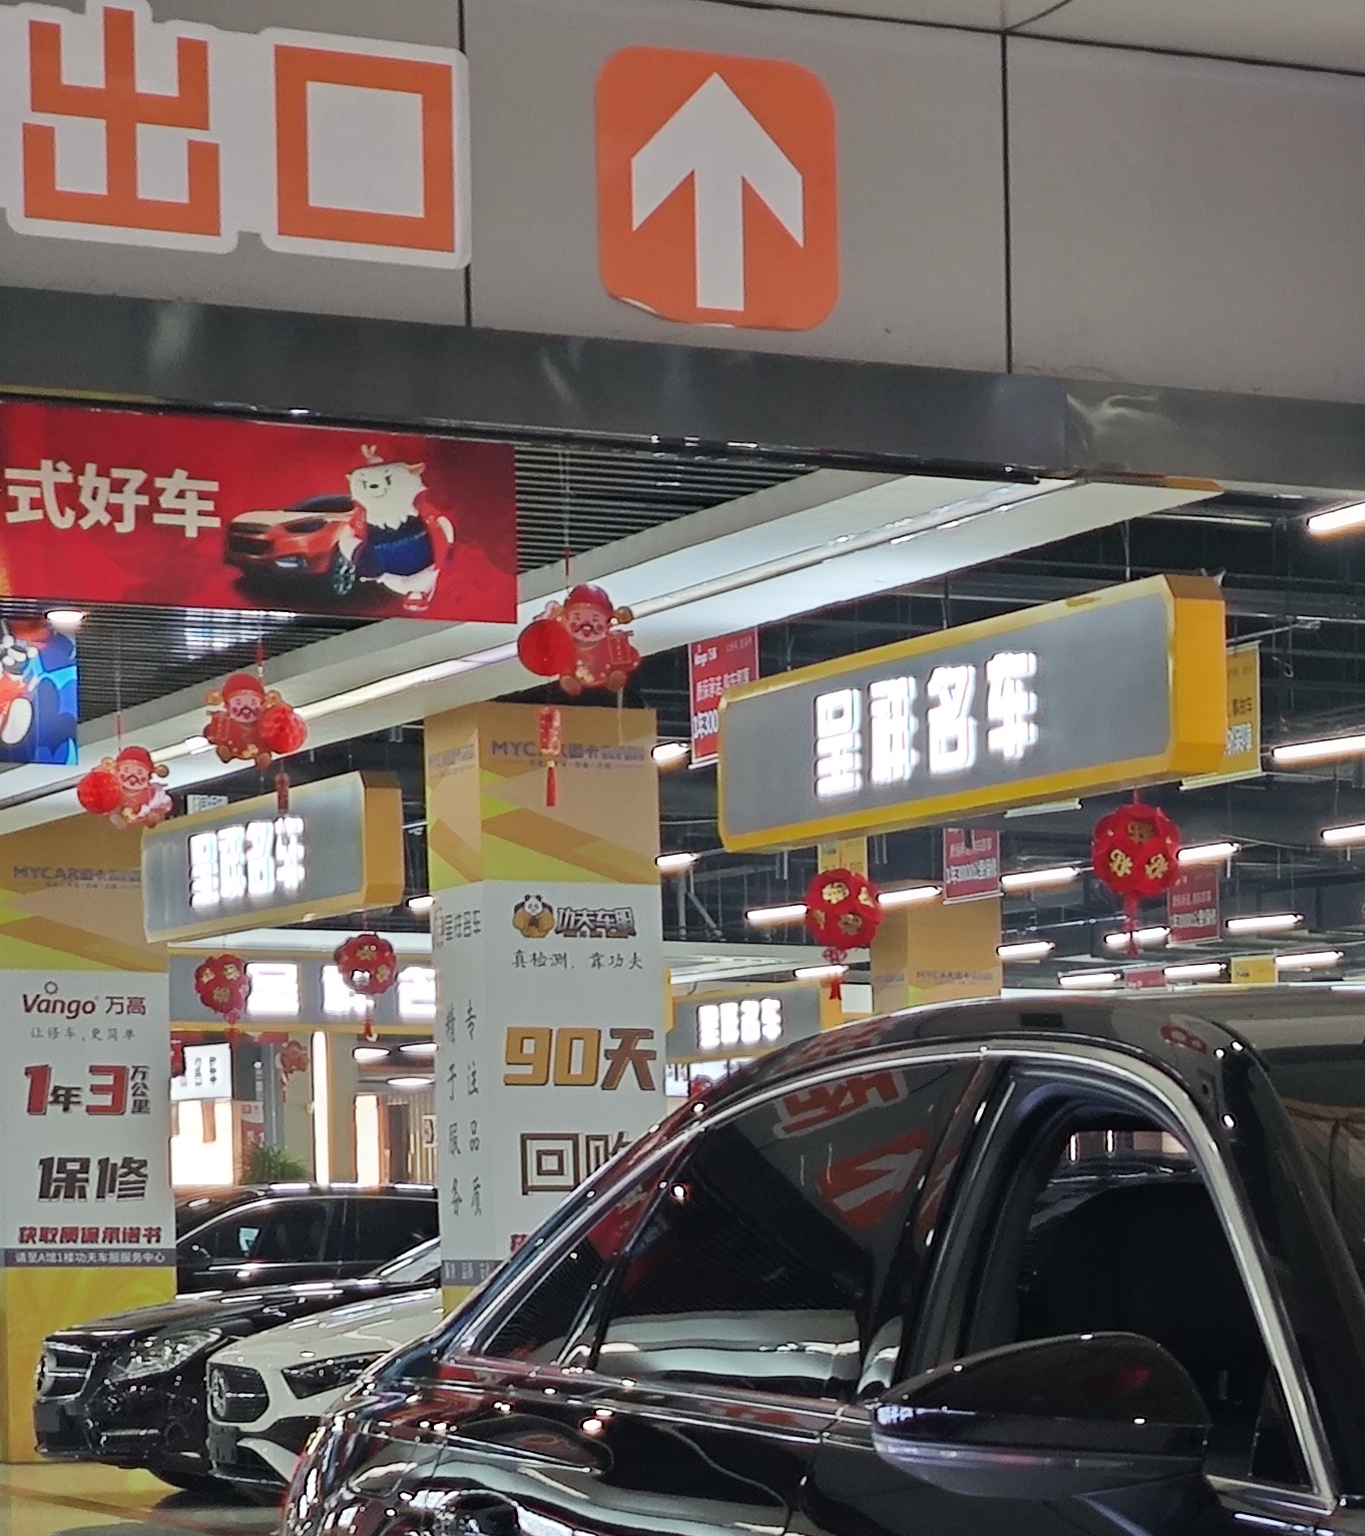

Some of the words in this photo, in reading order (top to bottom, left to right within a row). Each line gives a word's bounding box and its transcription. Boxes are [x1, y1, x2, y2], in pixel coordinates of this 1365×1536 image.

[22, 7, 456, 252] 出口
[3, 457, 222, 538] 式好车
[812, 650, 1040, 799] 呈祥名车
[23, 994, 96, 1019] Vango
[105, 996, 147, 1015] 万高
[503, 1027, 656, 1090] 90天
[38, 1157, 148, 1200] 保修
